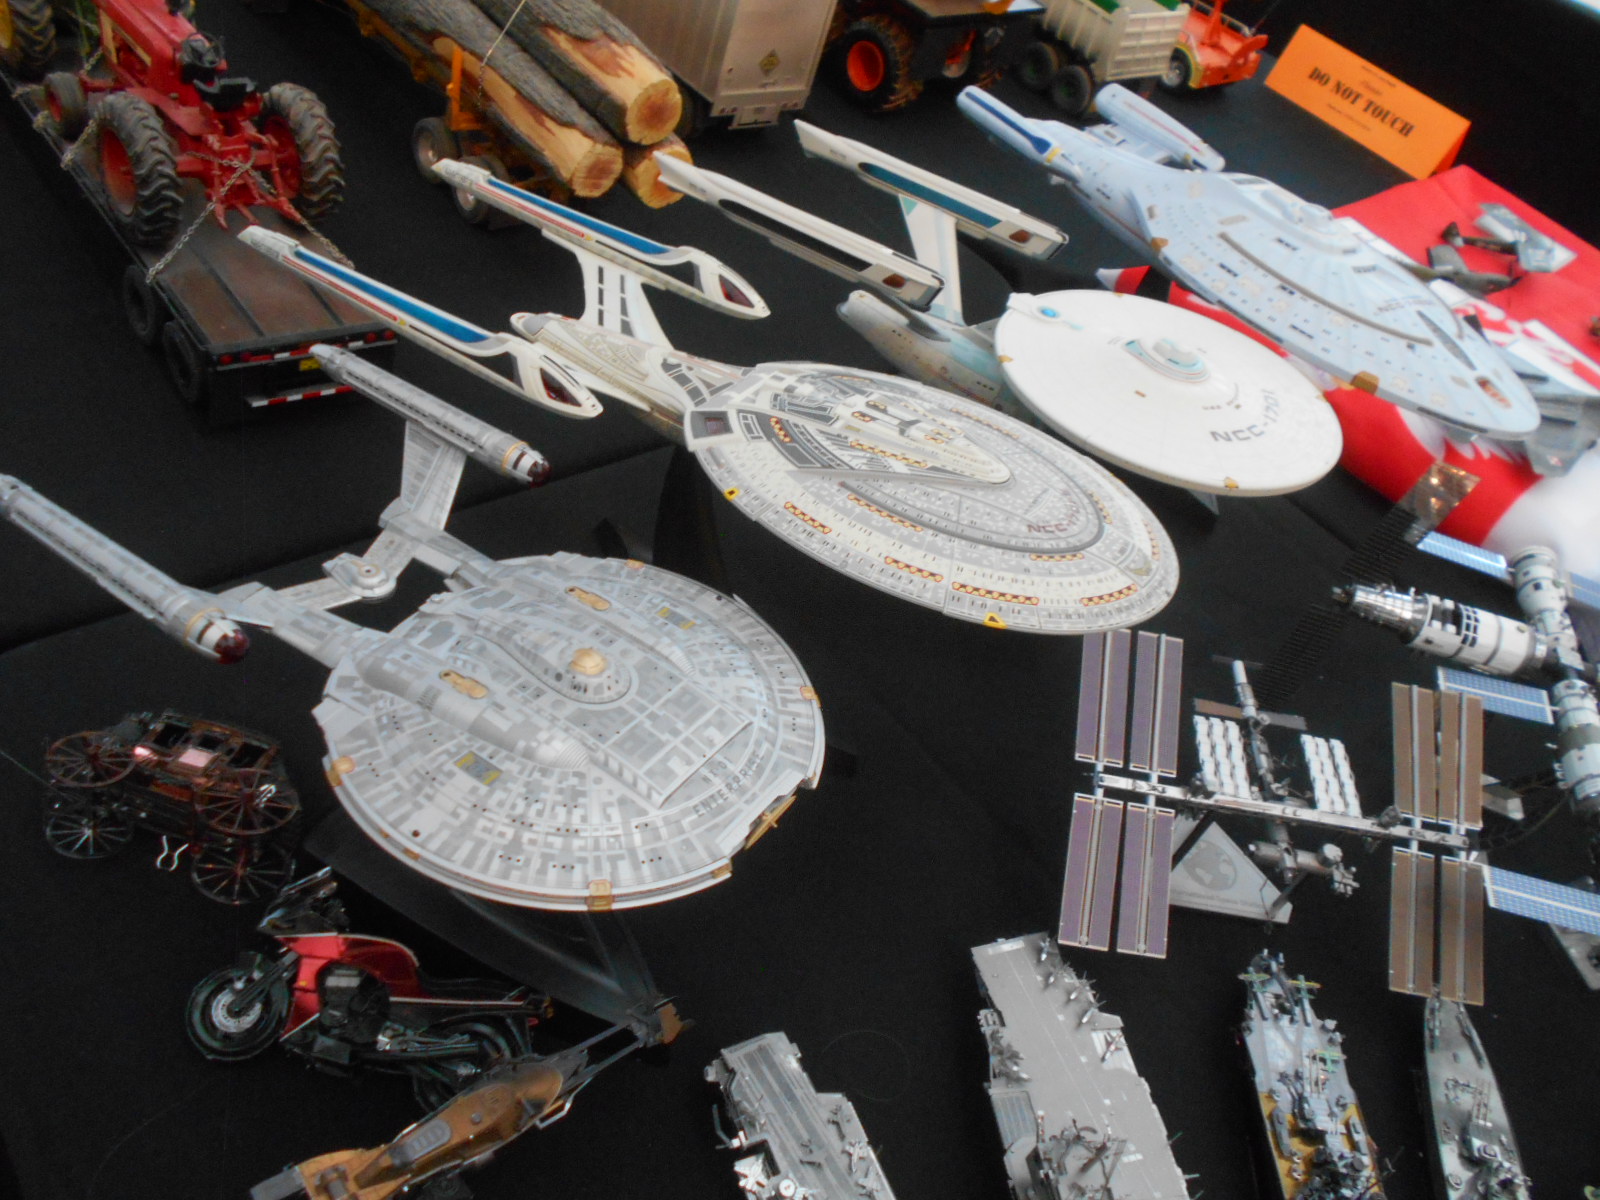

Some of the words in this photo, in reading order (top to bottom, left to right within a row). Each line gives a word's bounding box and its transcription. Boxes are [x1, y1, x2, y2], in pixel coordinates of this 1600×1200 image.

[1308, 67, 1331, 86] DO
[1332, 80, 1363, 105] NOT
[1363, 99, 1415, 137] TOUCH
[692, 751, 765, 818] ENTERPRISE
